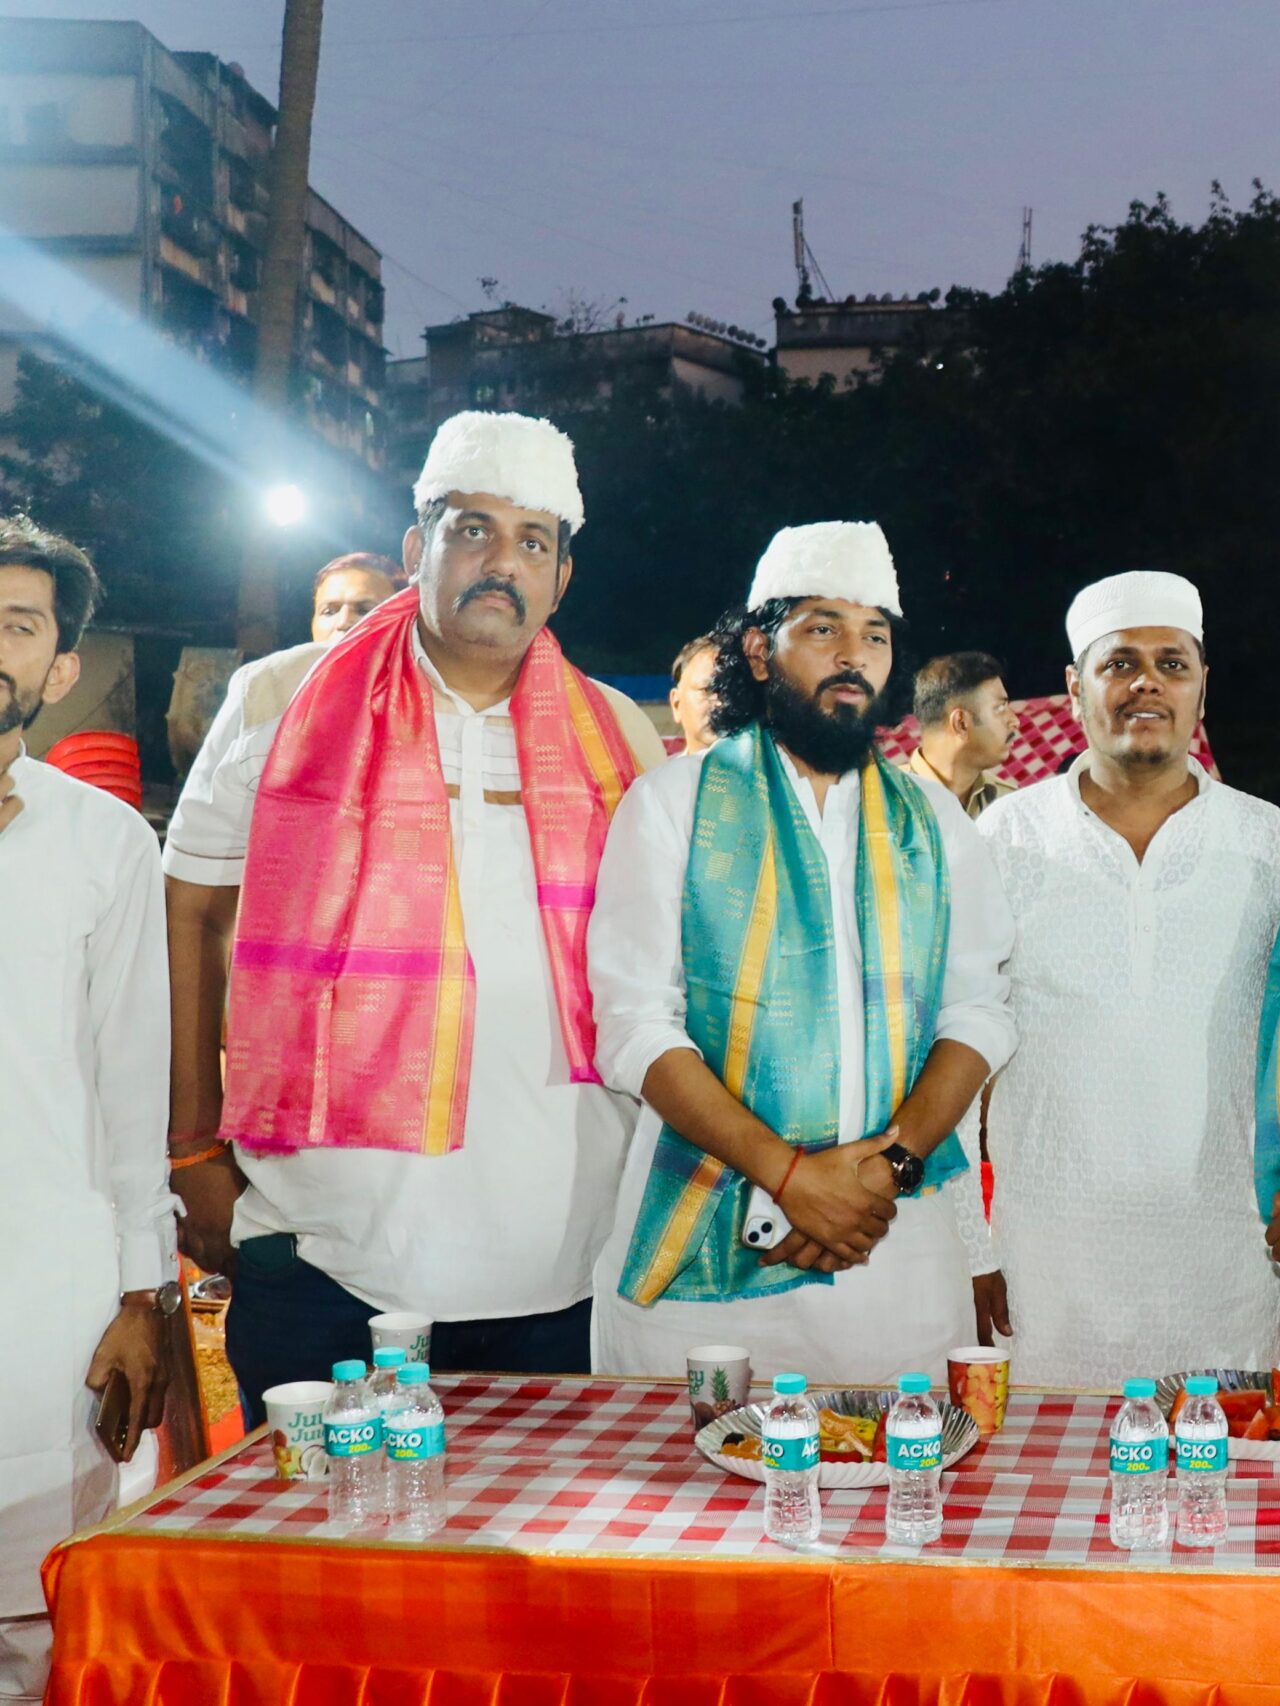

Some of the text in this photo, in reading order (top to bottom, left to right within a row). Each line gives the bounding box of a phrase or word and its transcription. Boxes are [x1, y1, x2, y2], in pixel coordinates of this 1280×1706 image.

[328, 1425, 374, 1444] ACKO
[898, 1440, 941, 1458] ACKO
[1110, 1443, 1153, 1461] ACKO
